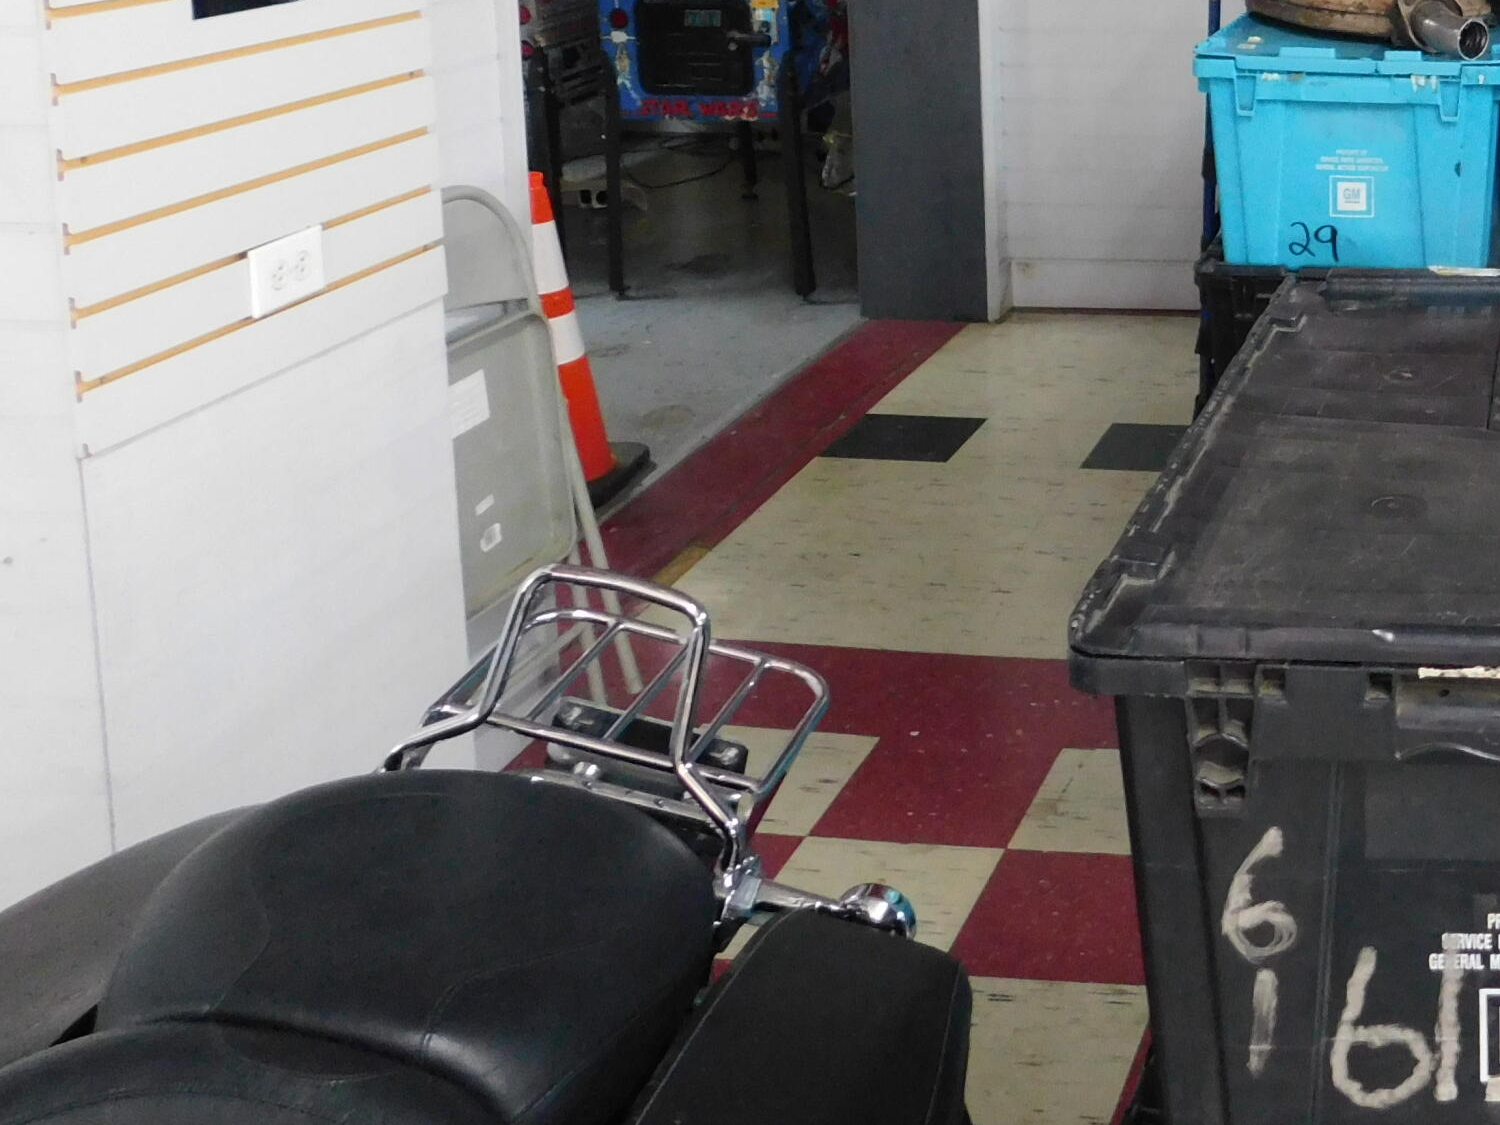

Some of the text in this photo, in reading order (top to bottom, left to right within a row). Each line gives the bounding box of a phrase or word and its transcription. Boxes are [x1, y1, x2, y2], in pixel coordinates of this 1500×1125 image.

[1344, 188, 1361, 200] GM
[1288, 222, 1339, 263] 29
[1428, 952, 1485, 971] GEERAL
[1330, 946, 1462, 1110] 61
